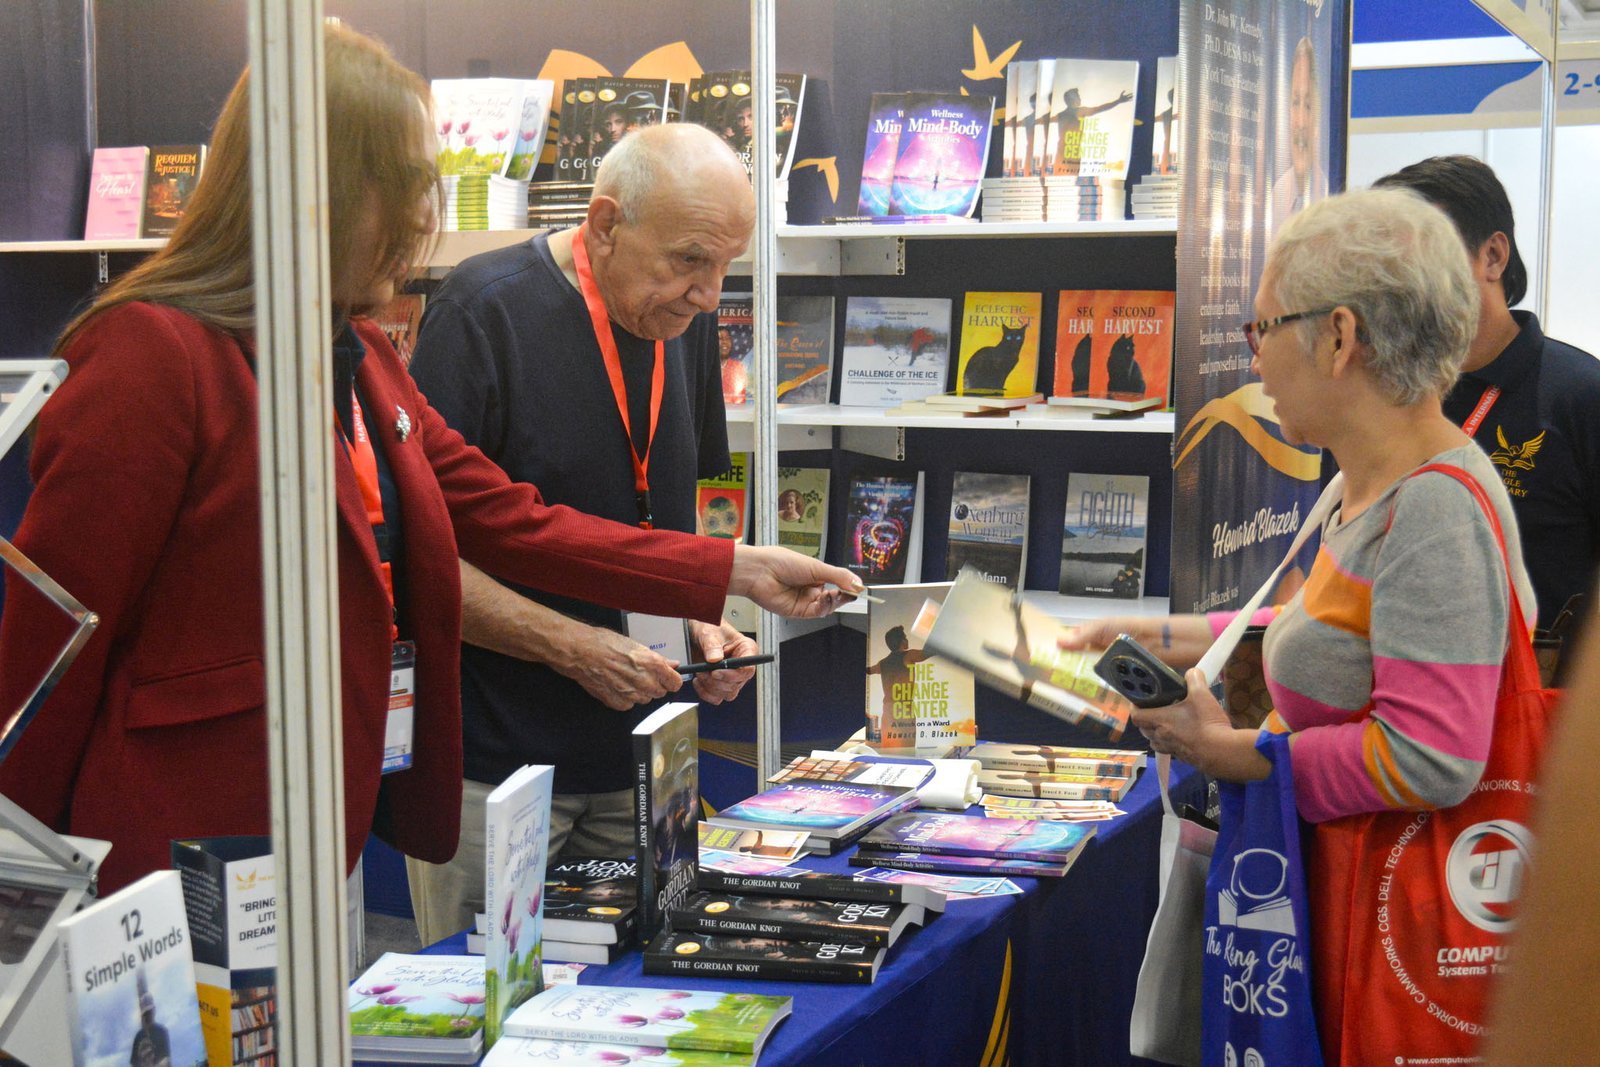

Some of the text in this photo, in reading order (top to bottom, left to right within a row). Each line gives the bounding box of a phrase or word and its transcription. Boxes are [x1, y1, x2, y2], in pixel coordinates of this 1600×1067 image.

[931, 109, 963, 119] Wellness
[908, 118, 983, 139] Mind-Body
[1078, 117, 1099, 131] THE
[1064, 131, 1109, 145] CHANGE
[1064, 145, 1107, 159] CENTER
[155, 154, 197, 168] REQUIEM
[975, 305, 1027, 314] ECLECTIC
[1113, 306, 1156, 318] SECOND
[968, 315, 1035, 328] HARVEST
[1104, 319, 1163, 335] HARVEST
[848, 369, 894, 378] CHALLENGE
[1212, 501, 1300, 559] Howard Blazek
[978, 572, 1007, 584] Mann
[907, 663, 935, 682] THE
[892, 681, 950, 701] CHANGE
[893, 700, 949, 720] CENTER
[931, 729, 958, 738] Blazek
[639, 784, 648, 822] GORDIAN
[640, 823, 648, 848] KNOT
[657, 861, 696, 911] GORDIAN
[722, 877, 802, 890] THE GORDIAN KNOT
[1377, 873, 1393, 901] DELL
[120, 908, 144, 942] 12
[699, 919, 783, 934] THE GORDIAN KNOT
[1206, 926, 1222, 956] The
[85, 953, 136, 992] Simple
[138, 925, 183, 962] Words
[672, 961, 760, 973] THE GORDIAN KNOT
[1437, 965, 1487, 977] Systems
[1223, 974, 1289, 1018] BOKS
[551, 1030, 564, 1038] THE
[566, 1032, 587, 1040] LORD
[588, 1033, 608, 1041] WITH
